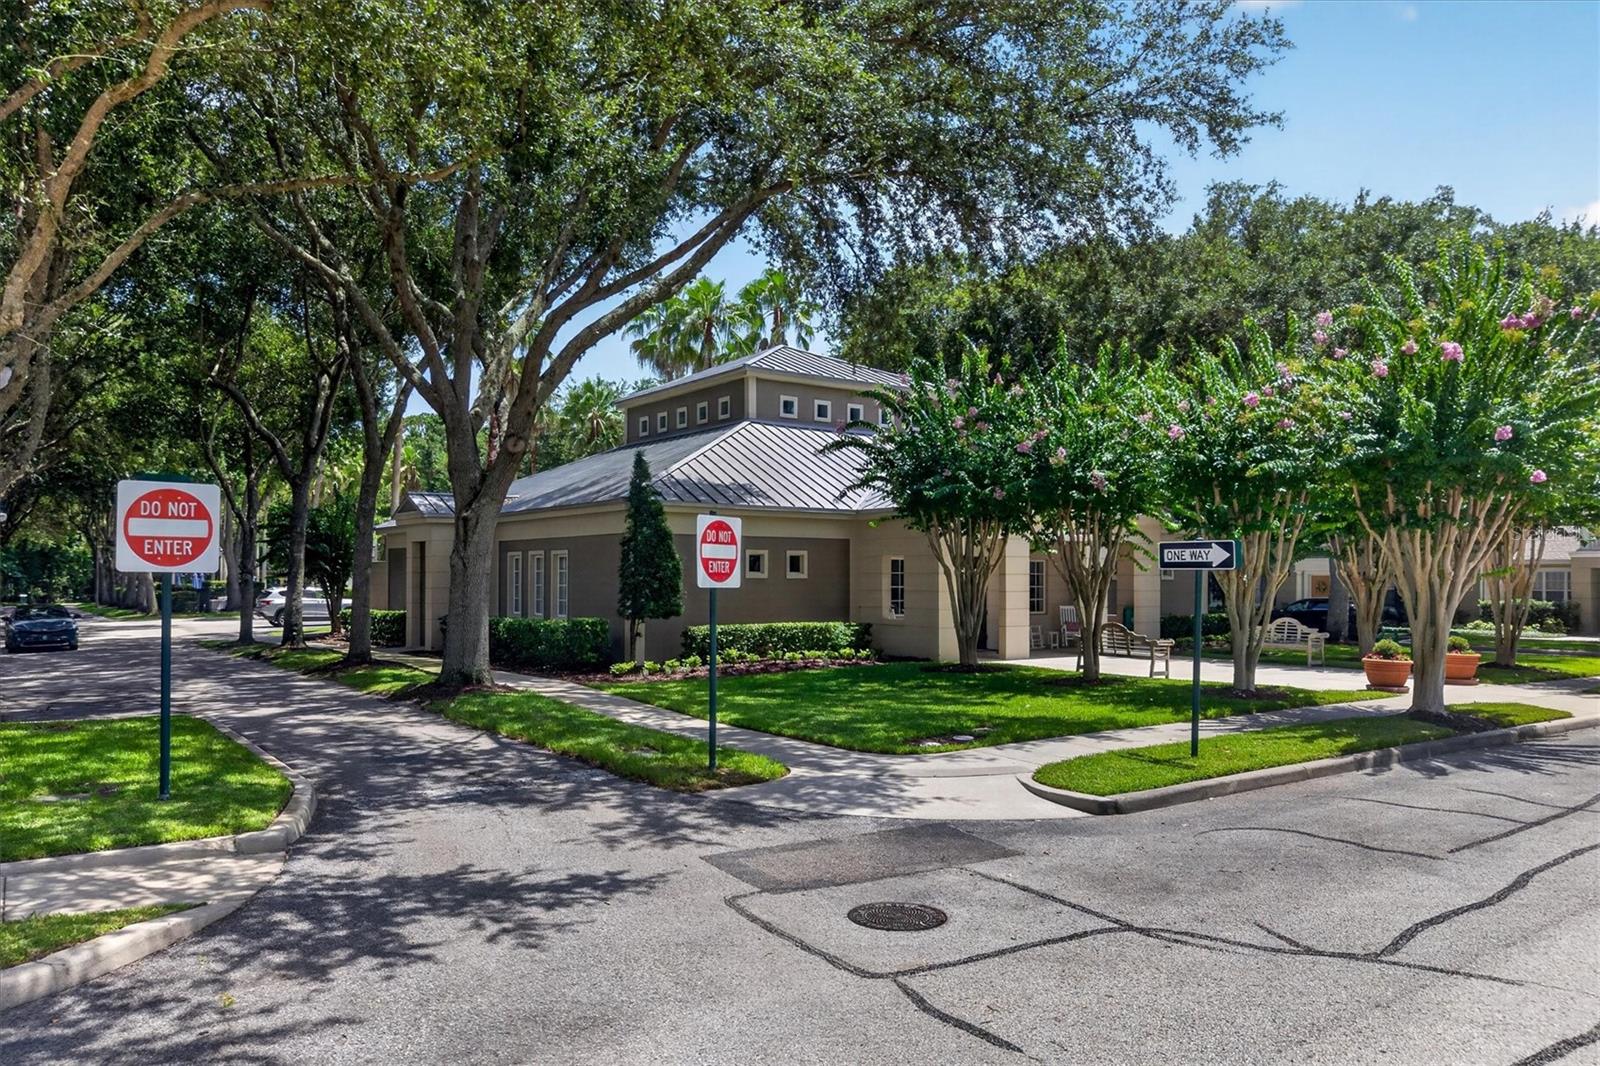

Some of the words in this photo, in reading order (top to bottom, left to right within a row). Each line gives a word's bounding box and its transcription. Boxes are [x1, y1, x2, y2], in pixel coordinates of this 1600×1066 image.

[140, 501, 161, 516] DO
[168, 502, 197, 517] NOT
[706, 529, 717, 542] DO
[718, 530, 732, 543] NOT
[144, 539, 193, 555] ENTER
[1166, 550, 1186, 561] ONE
[1189, 549, 1210, 561] WAY
[708, 560, 730, 574] ENTER
